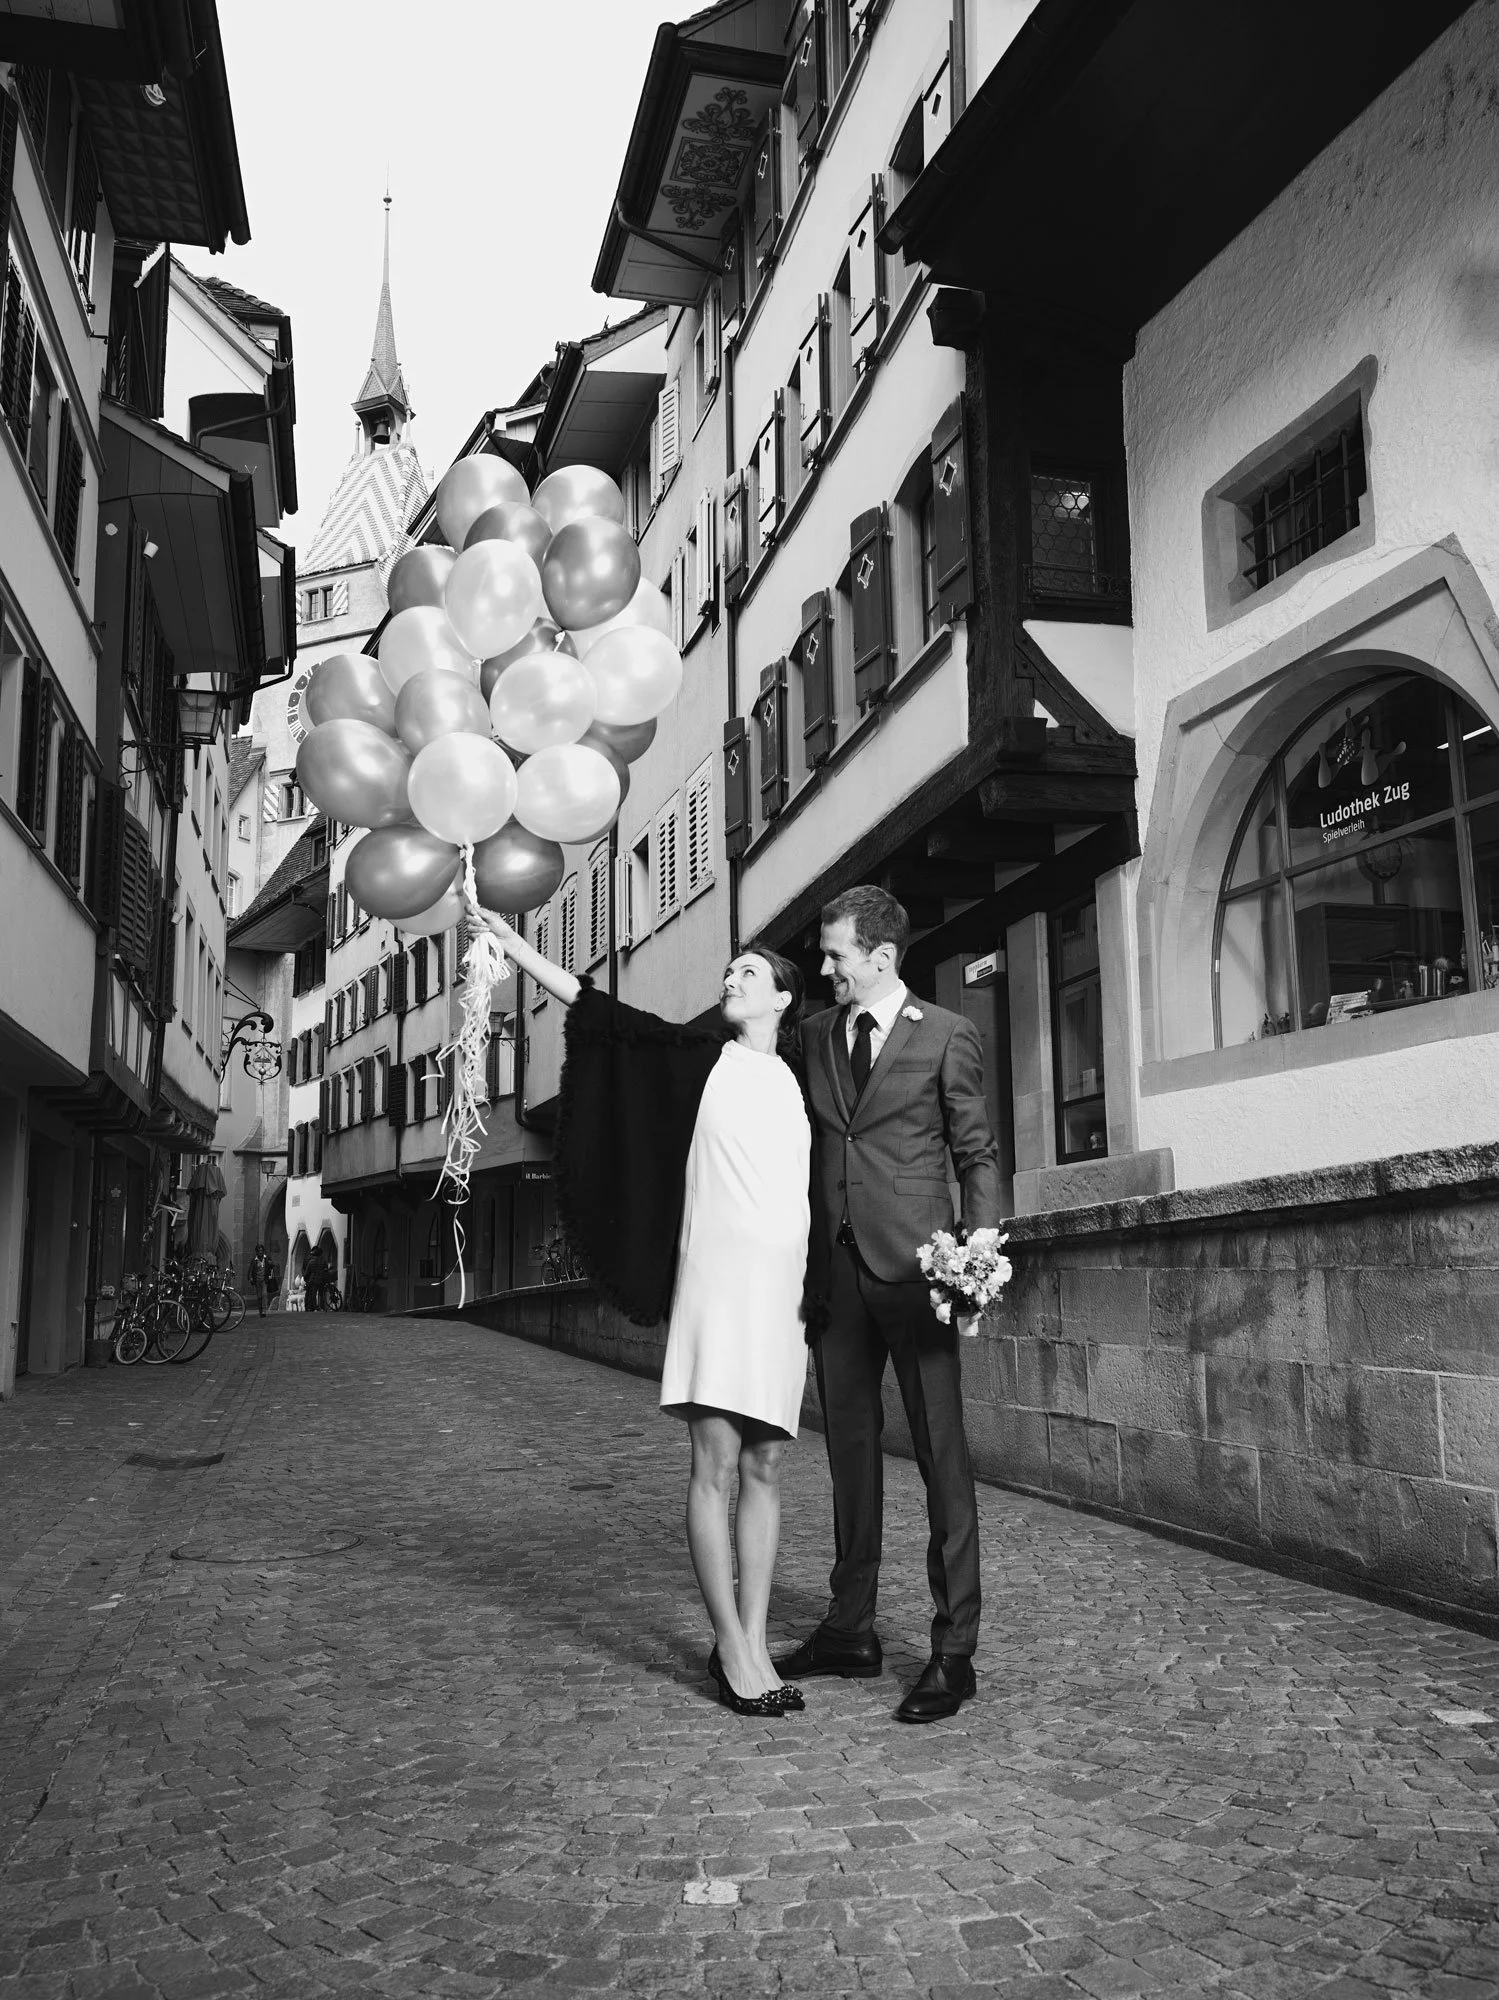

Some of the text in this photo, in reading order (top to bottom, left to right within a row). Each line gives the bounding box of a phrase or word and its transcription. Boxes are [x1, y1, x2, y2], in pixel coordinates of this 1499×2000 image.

[1320, 782, 1410, 828] Ludothek Zug
[1322, 819, 1365, 843] Spielverleih
